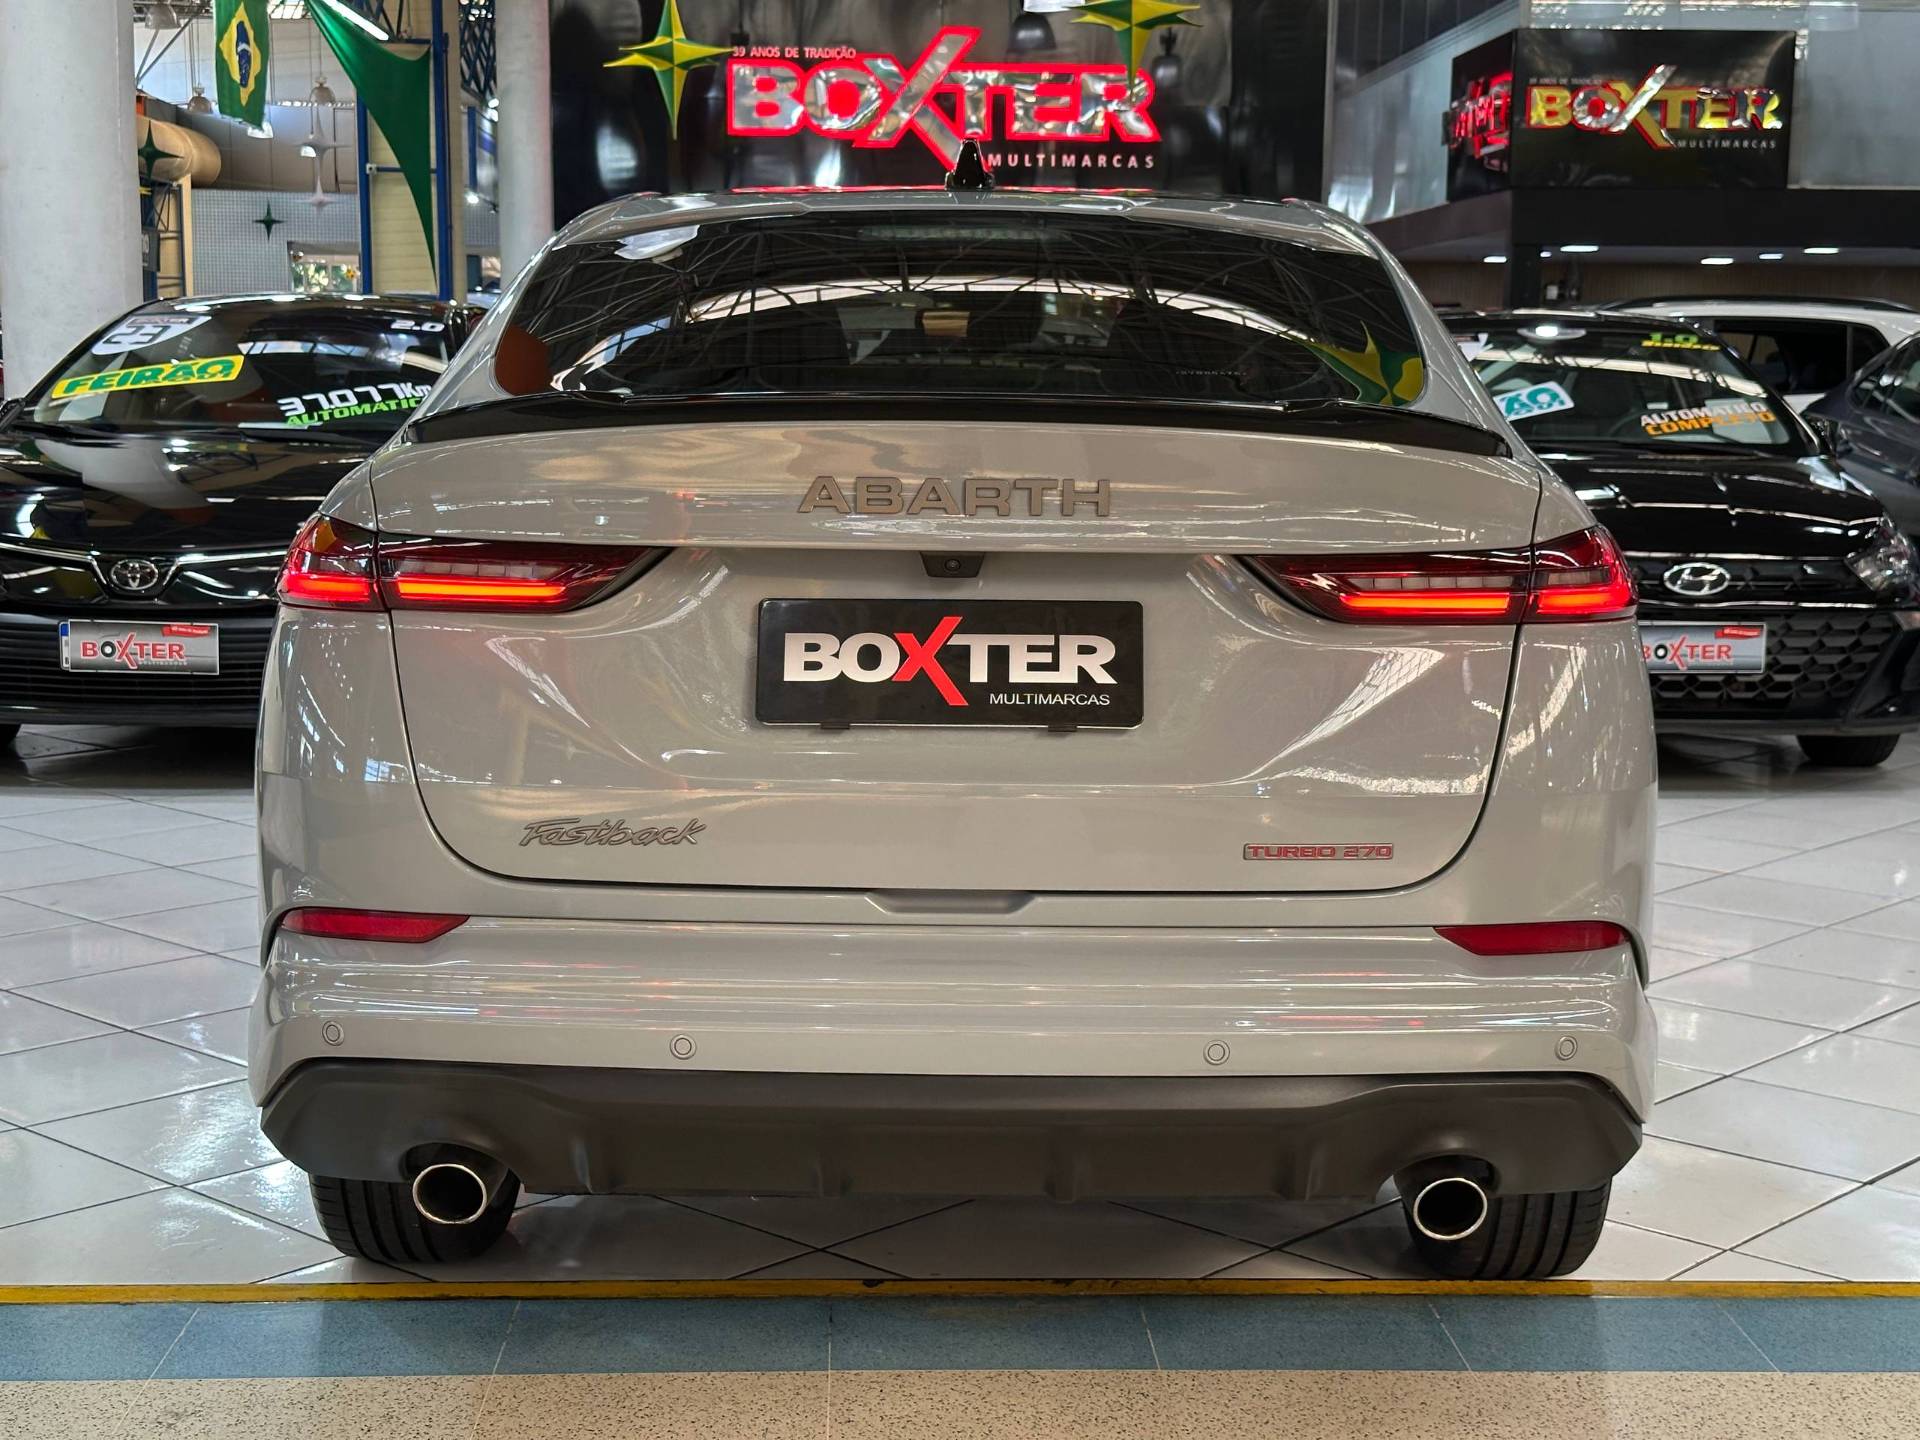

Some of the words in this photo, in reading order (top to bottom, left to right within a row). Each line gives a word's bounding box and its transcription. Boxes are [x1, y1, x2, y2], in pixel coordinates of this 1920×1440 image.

[750, 46, 780, 57] ANOS
[785, 47, 799, 58] DE
[804, 45, 857, 60] TRADIÇÃO
[727, 26, 1162, 173] BOXTER
[1526, 64, 1783, 149] BOXTER
[1676, 139, 1778, 149] MULTIMARCAS
[987, 153, 1155, 169] MULTIMARCAS
[390, 319, 446, 332] 2.0
[1650, 332, 1698, 344] 1.0
[63, 359, 236, 395] FEIRÃO
[797, 475, 1111, 517] ABARTH
[80, 632, 186, 669] BOXTER
[783, 616, 1118, 706] BOXTER
[989, 693, 1111, 706] MULTIMARCAS
[518, 817, 706, 846] Fastback
[1247, 846, 1336, 858] TURBO
[1343, 846, 1392, 858] 270
